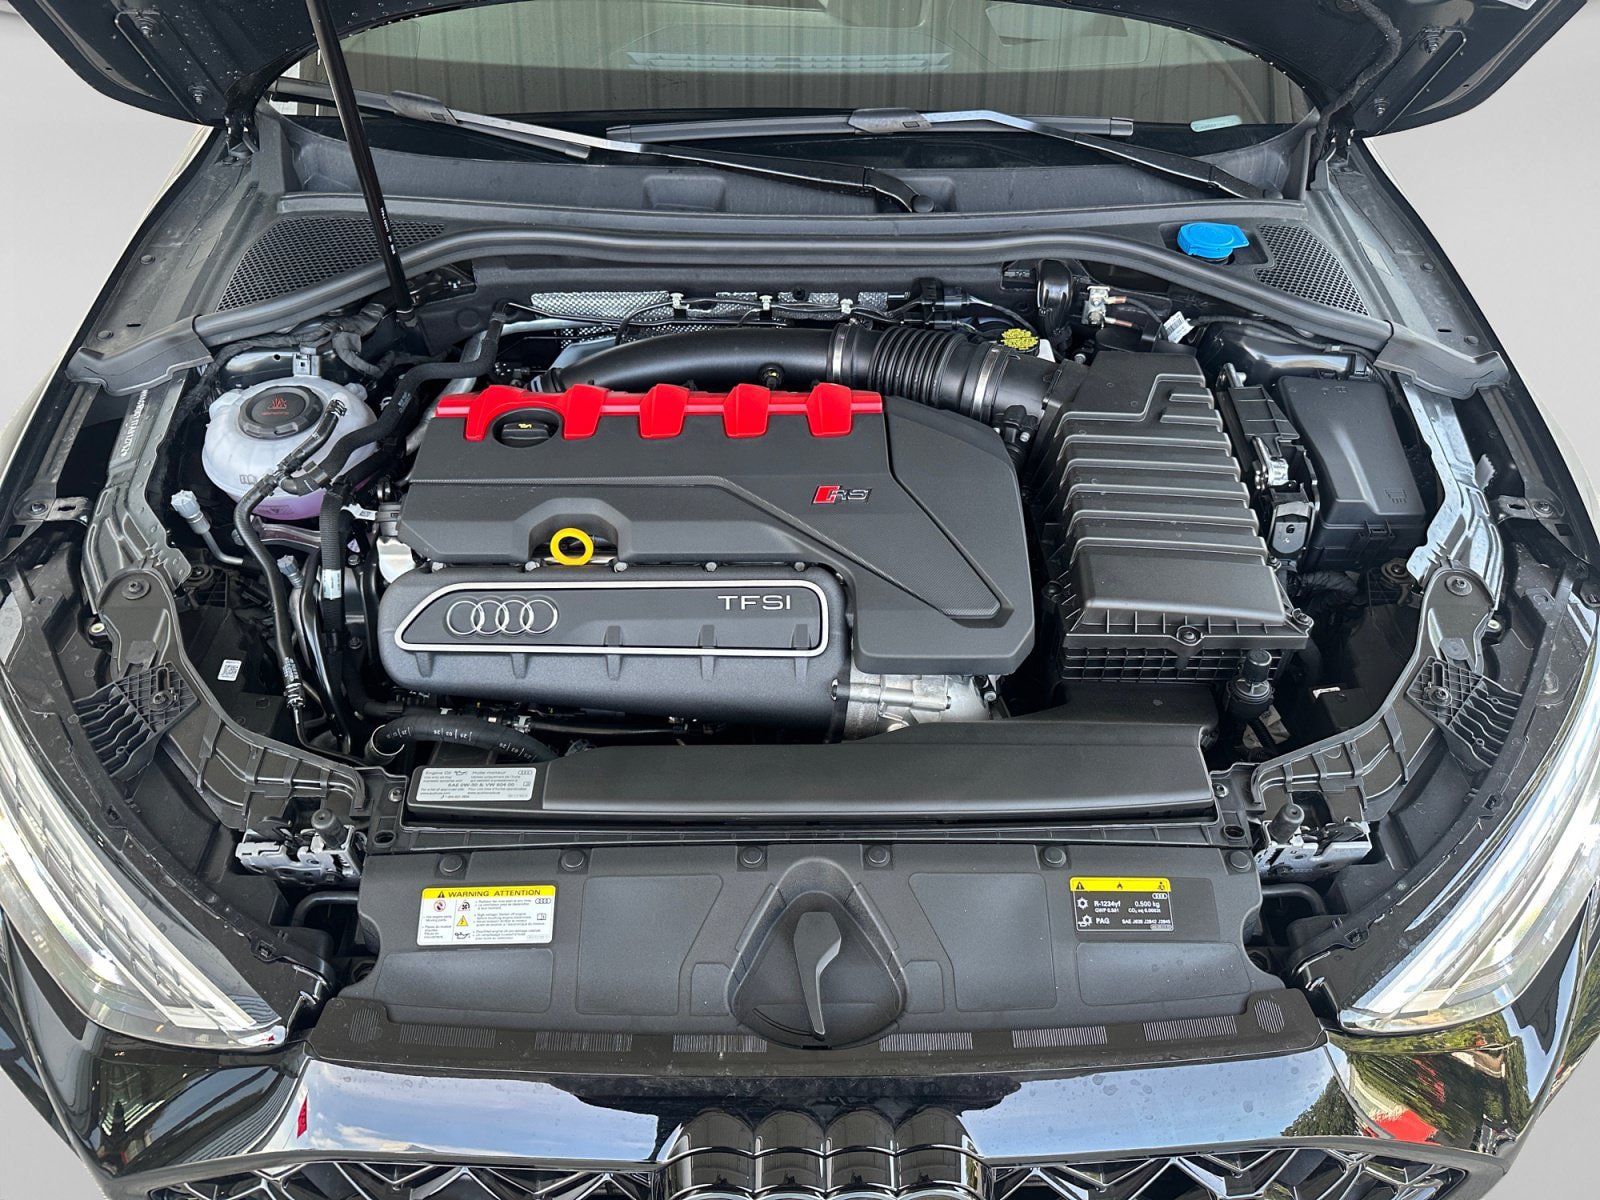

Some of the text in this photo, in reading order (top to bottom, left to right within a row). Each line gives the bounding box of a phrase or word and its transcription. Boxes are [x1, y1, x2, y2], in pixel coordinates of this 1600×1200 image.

[819, 485, 872, 504] RS
[717, 594, 791, 610] TFSI
[448, 889, 541, 898] WARNING ATTENTION
[1094, 900, 1121, 908] R-1234yf
[1152, 900, 1160, 908] kg
